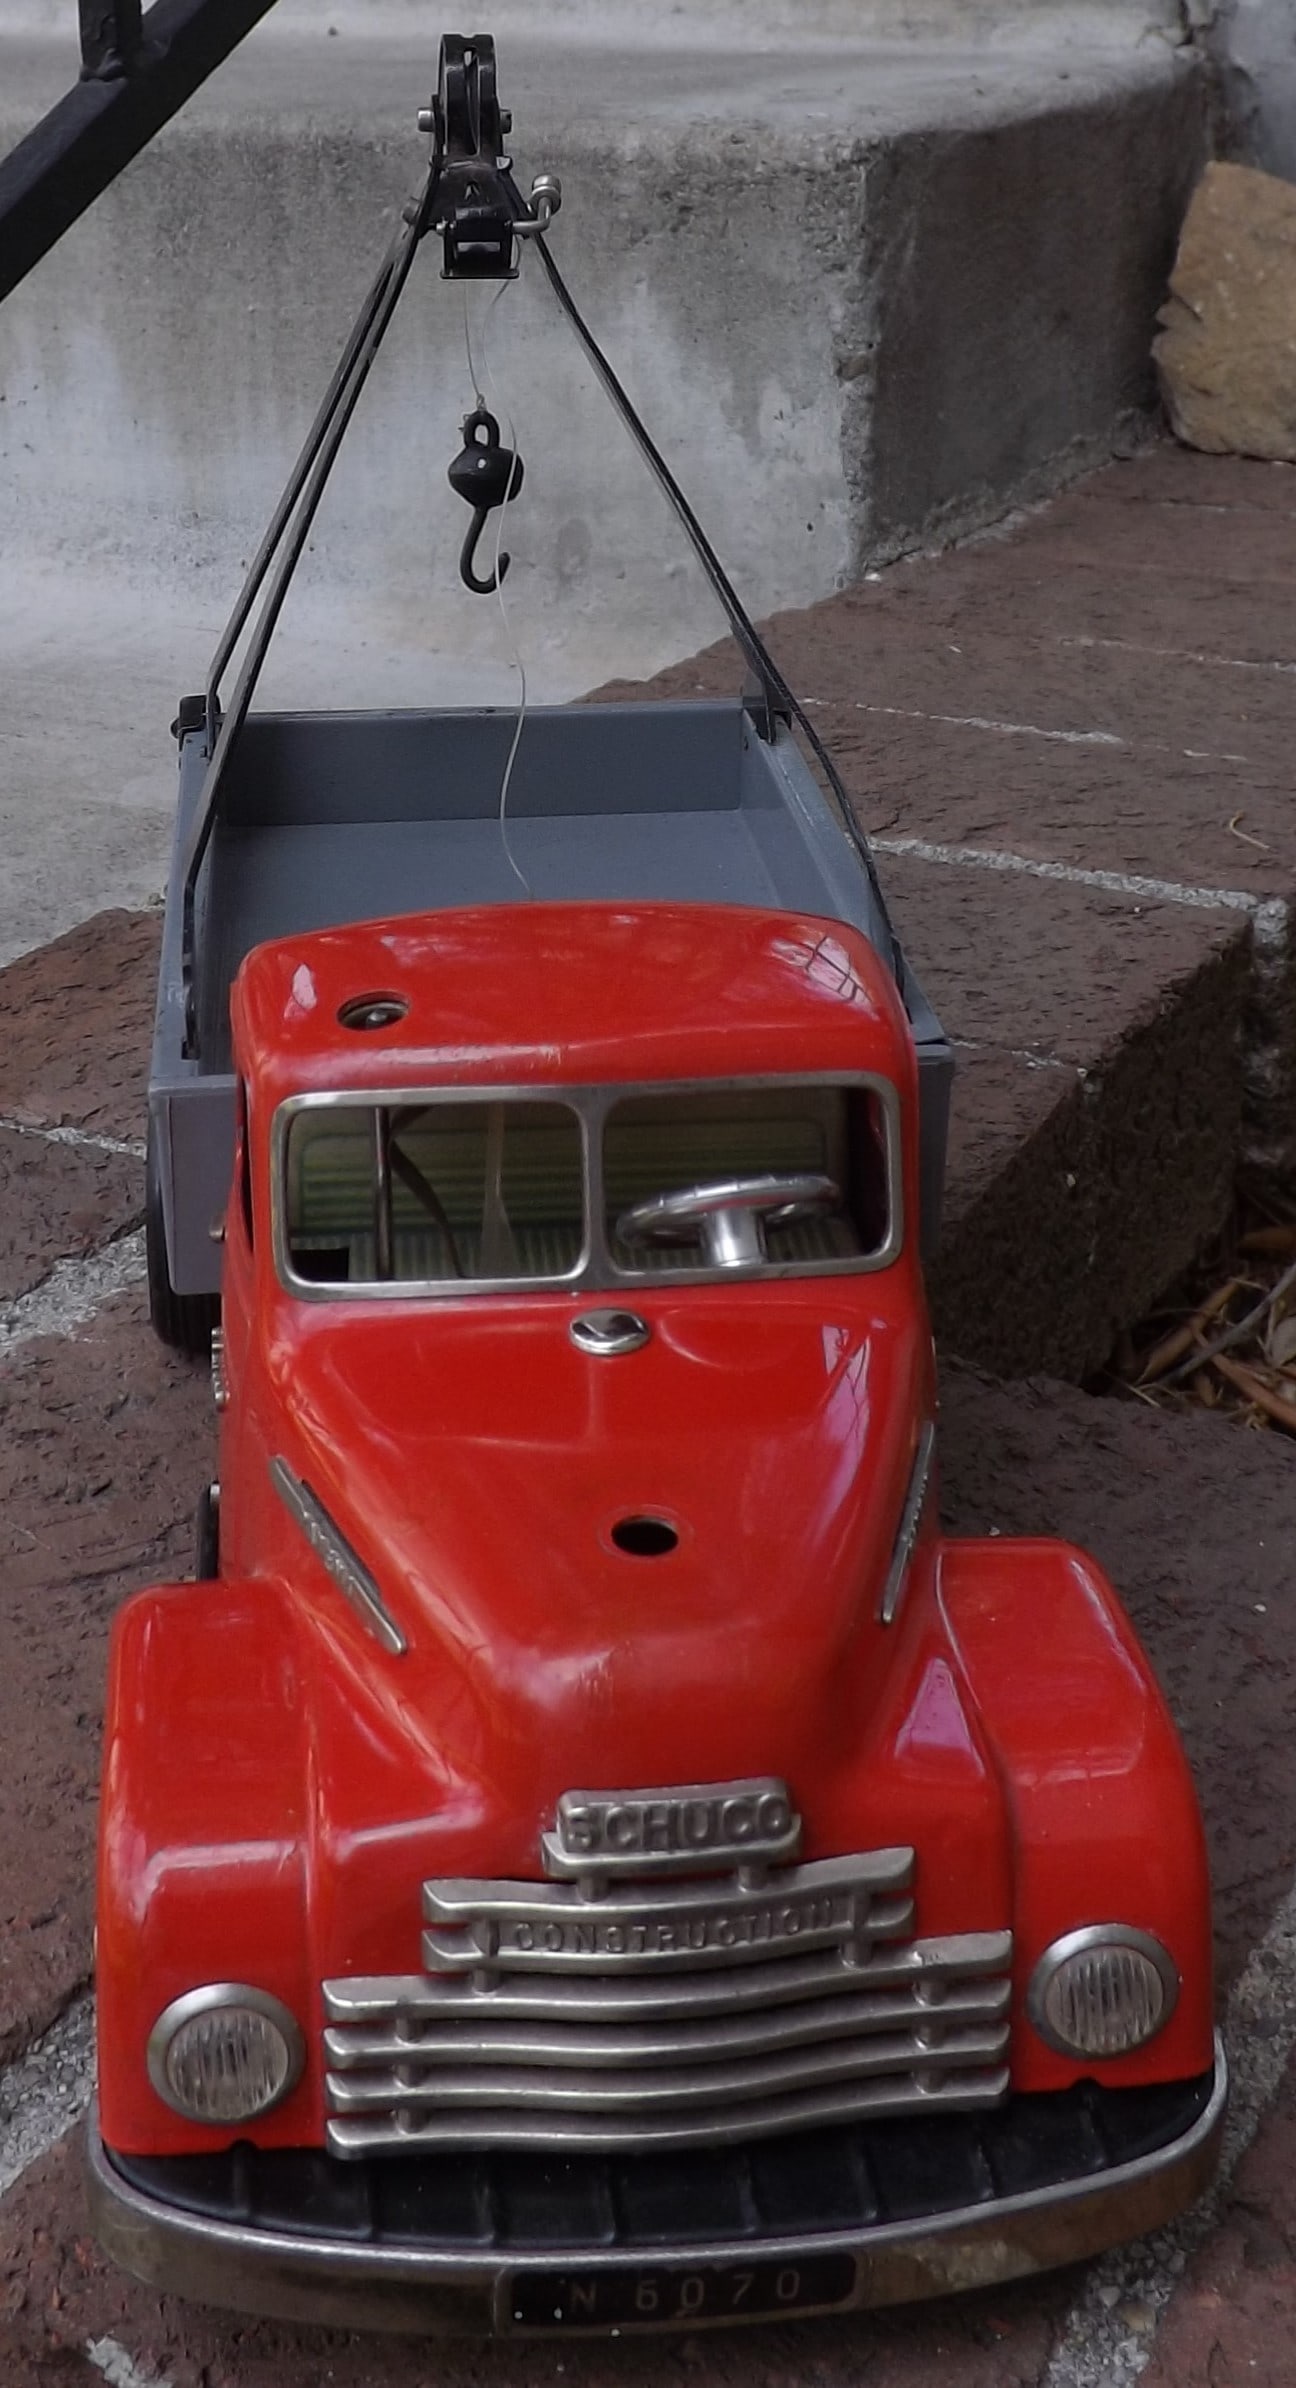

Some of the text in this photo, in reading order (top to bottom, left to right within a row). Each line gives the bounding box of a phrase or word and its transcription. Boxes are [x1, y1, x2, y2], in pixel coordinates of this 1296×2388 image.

[566, 1794, 791, 1853] SCHUCO
[514, 1899, 834, 1954] CONSTRUCTION
[635, 2269, 801, 2312] 6070
